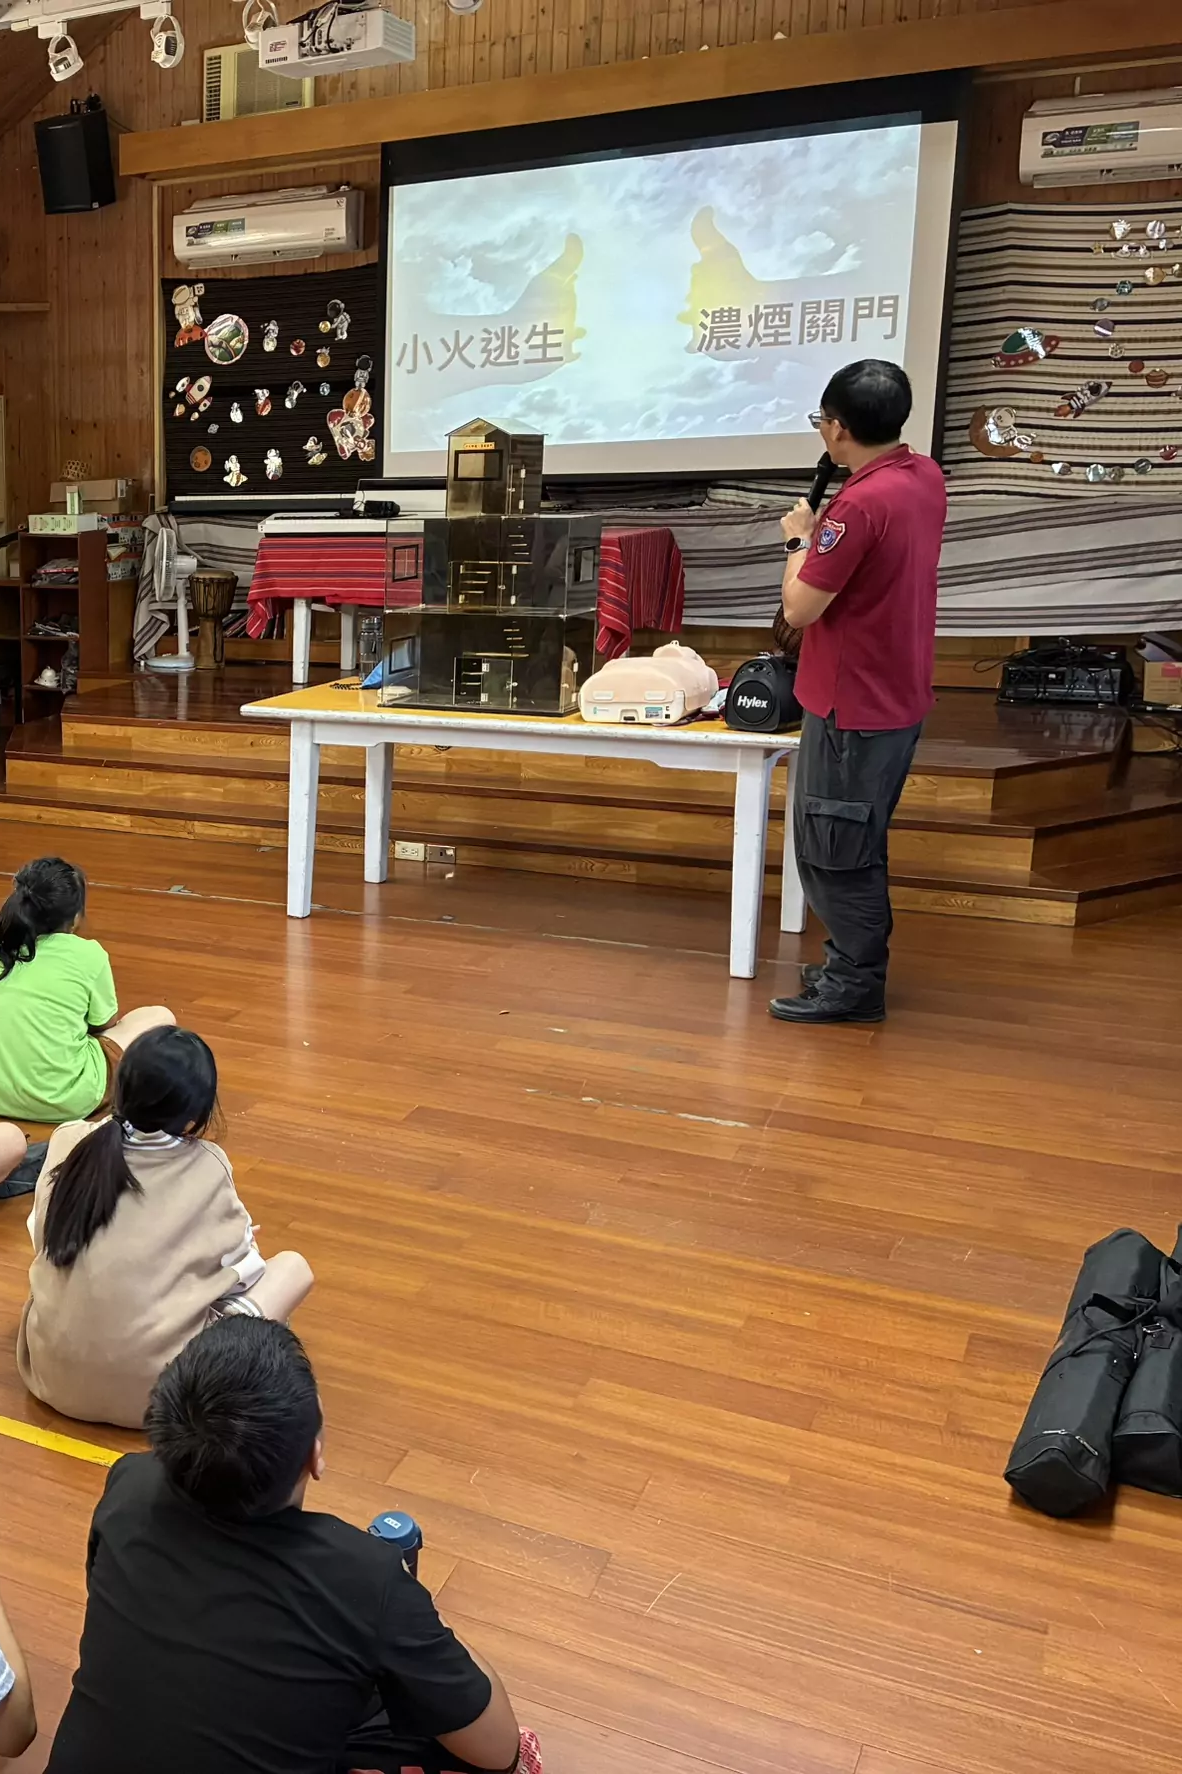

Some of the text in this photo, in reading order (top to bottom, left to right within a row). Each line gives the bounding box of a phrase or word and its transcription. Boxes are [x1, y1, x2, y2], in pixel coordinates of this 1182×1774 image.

[394, 322, 566, 376] 小火逃生
[696, 294, 900, 354] 濃煙關門
[737, 695, 768, 709] Hylex
